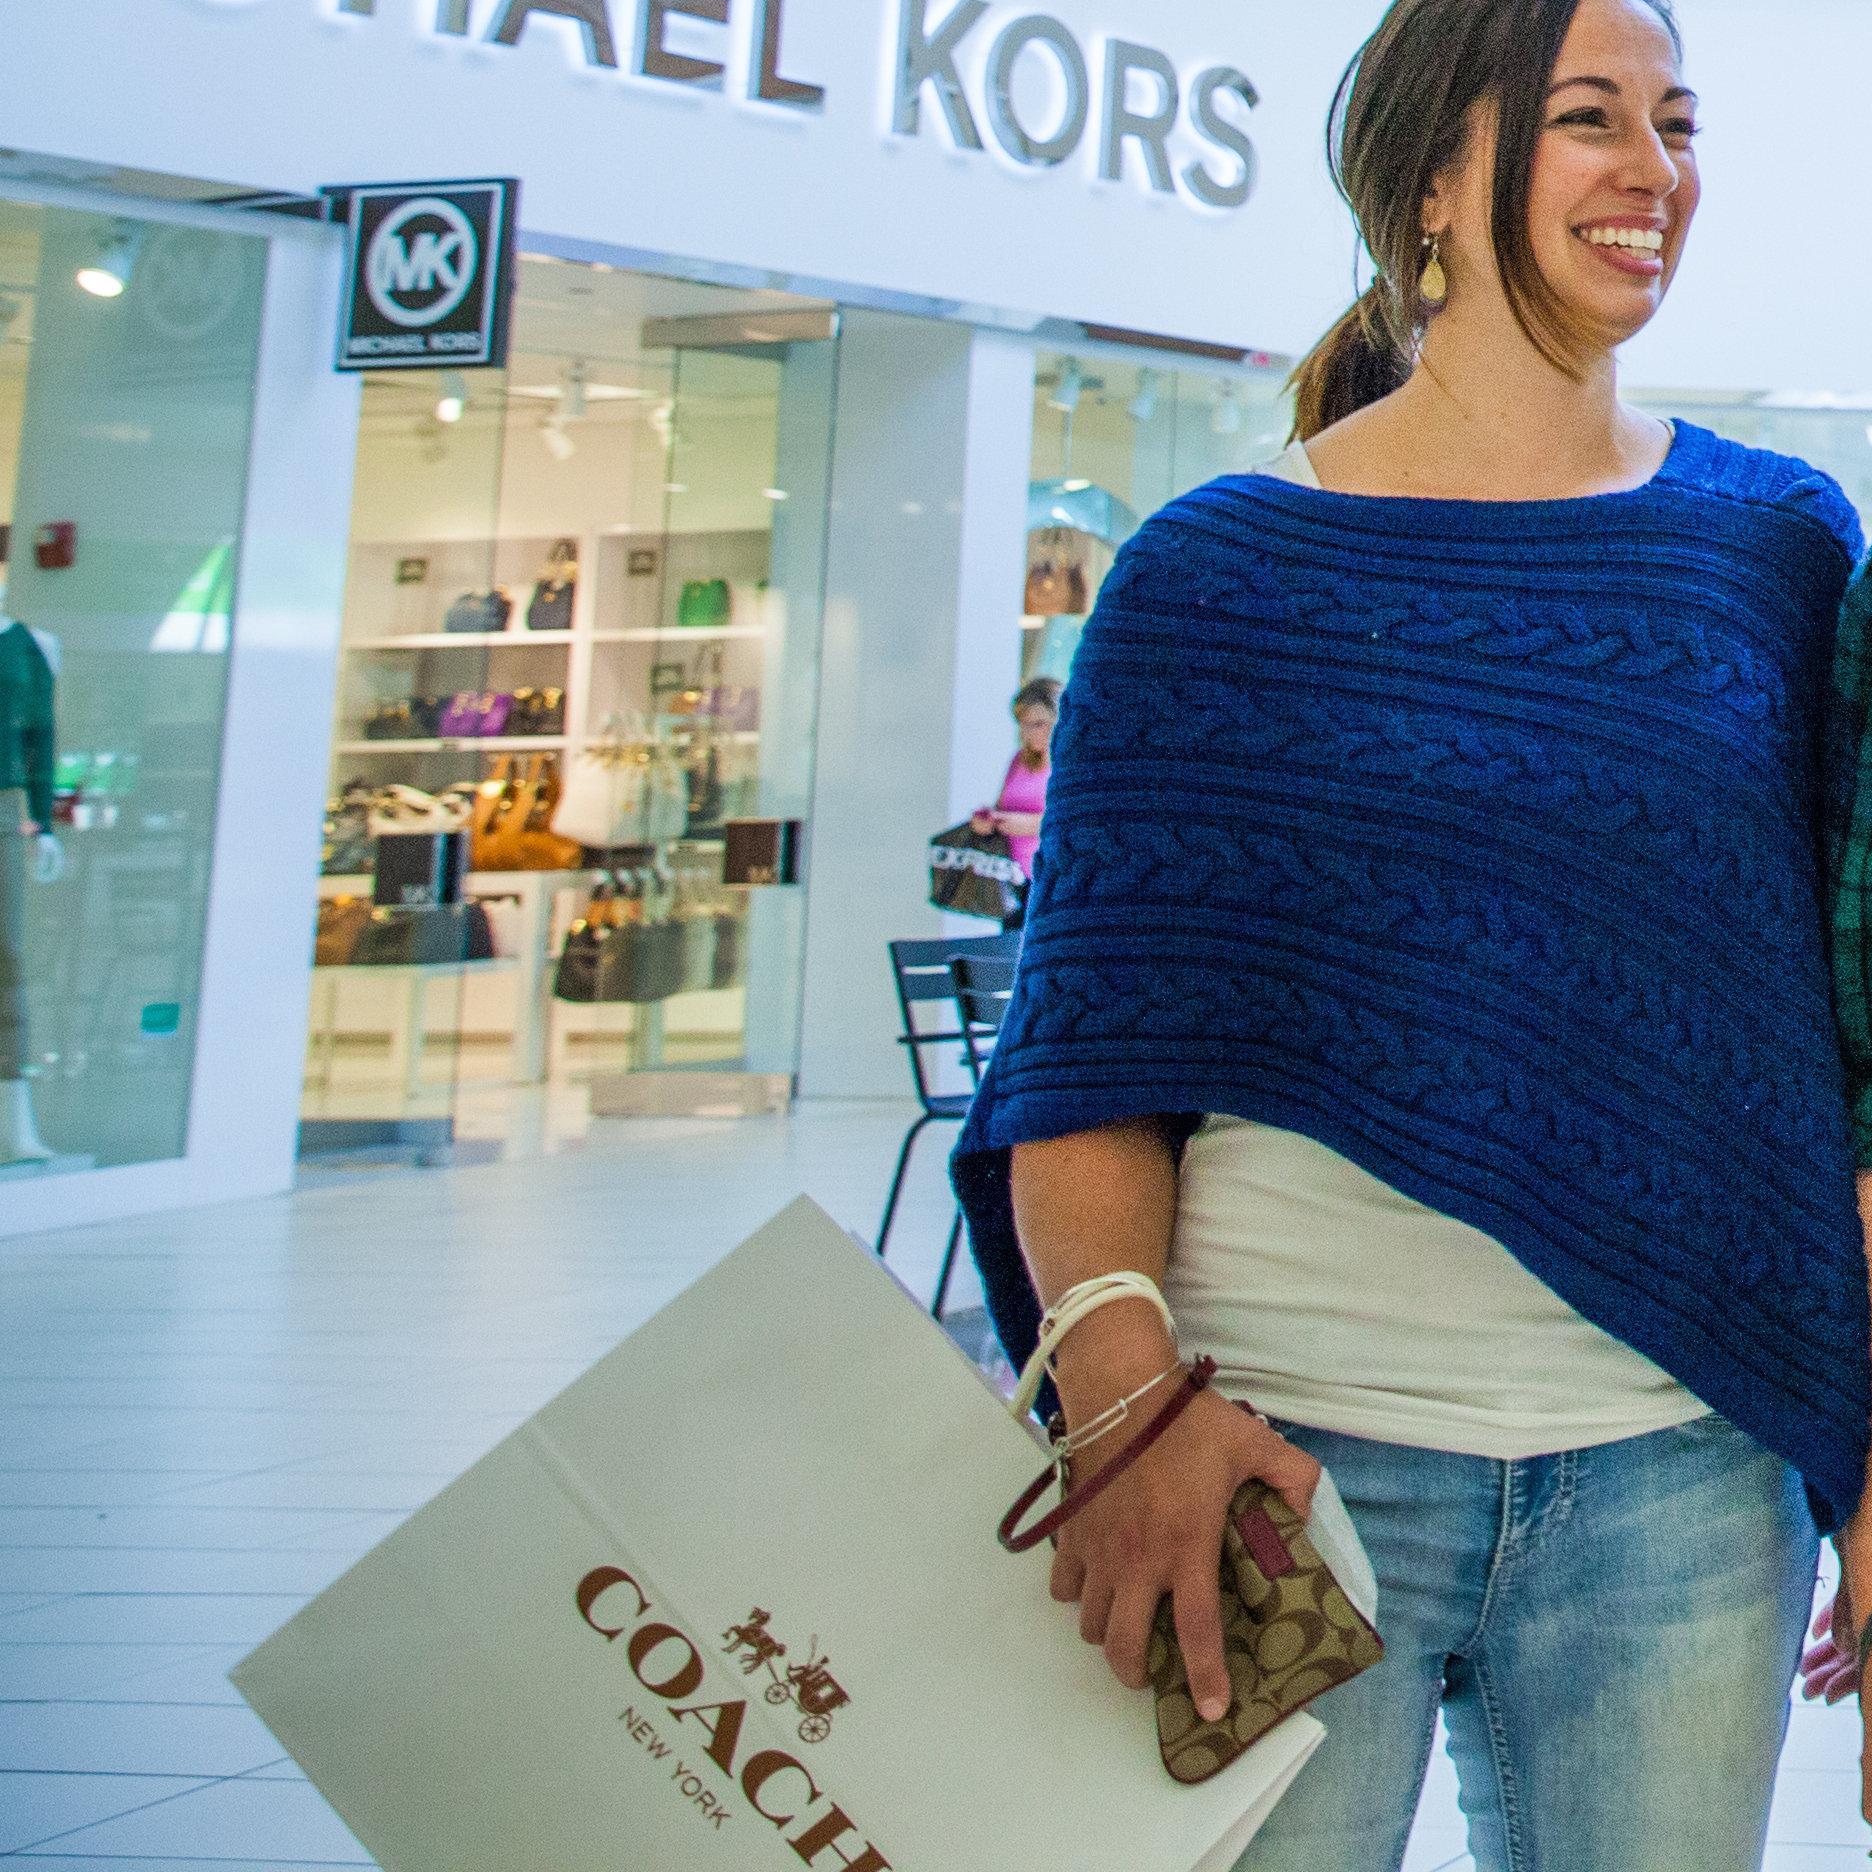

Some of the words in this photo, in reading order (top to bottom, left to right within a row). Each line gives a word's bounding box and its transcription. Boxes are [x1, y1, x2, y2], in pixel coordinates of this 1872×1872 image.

[576, 1565, 894, 1872] COACH
[616, 1705, 673, 1761] NEW
[670, 1760, 732, 1831] YORK
